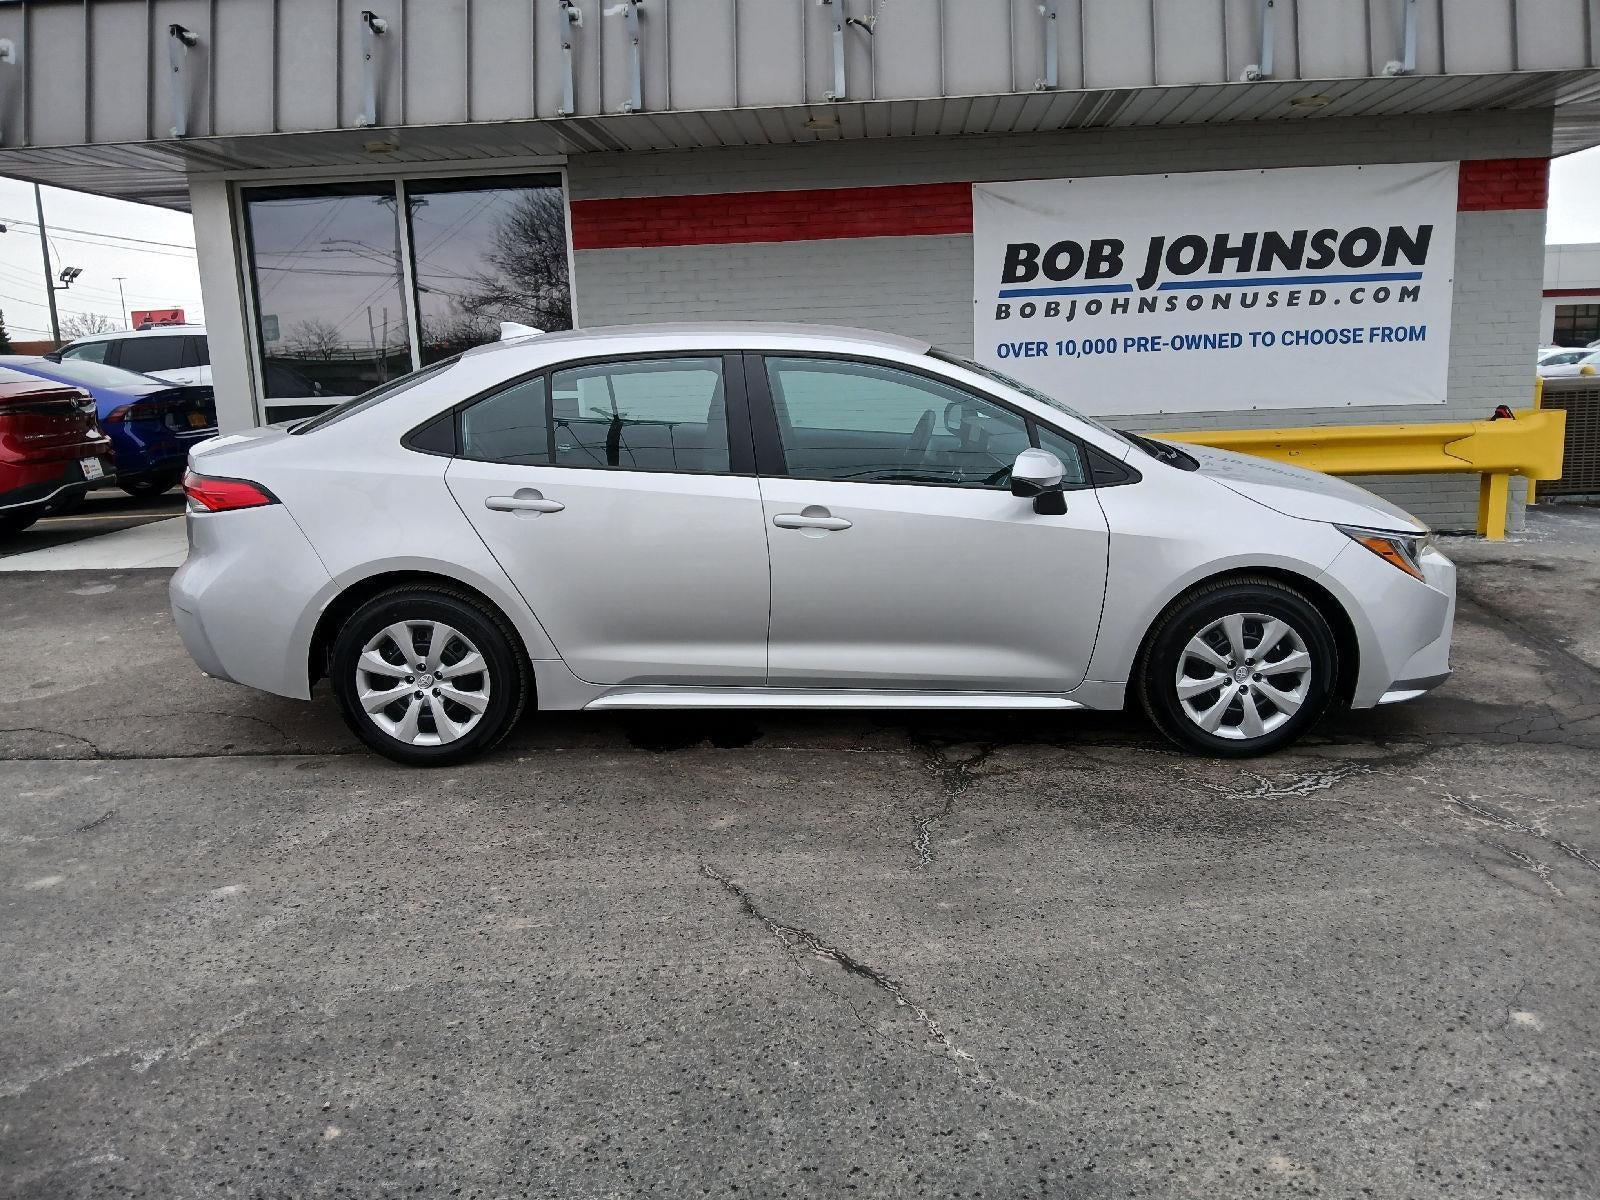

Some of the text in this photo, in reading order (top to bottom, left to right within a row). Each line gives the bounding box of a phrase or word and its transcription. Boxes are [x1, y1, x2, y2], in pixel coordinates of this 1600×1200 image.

[1000, 224, 1434, 291] BOB JOHNSON
[994, 285, 1422, 323] BOBJOHNSONUSED.COM
[996, 325, 1427, 359] OVER 10,000 PRE-OWNED TO CHOOSE FROM
